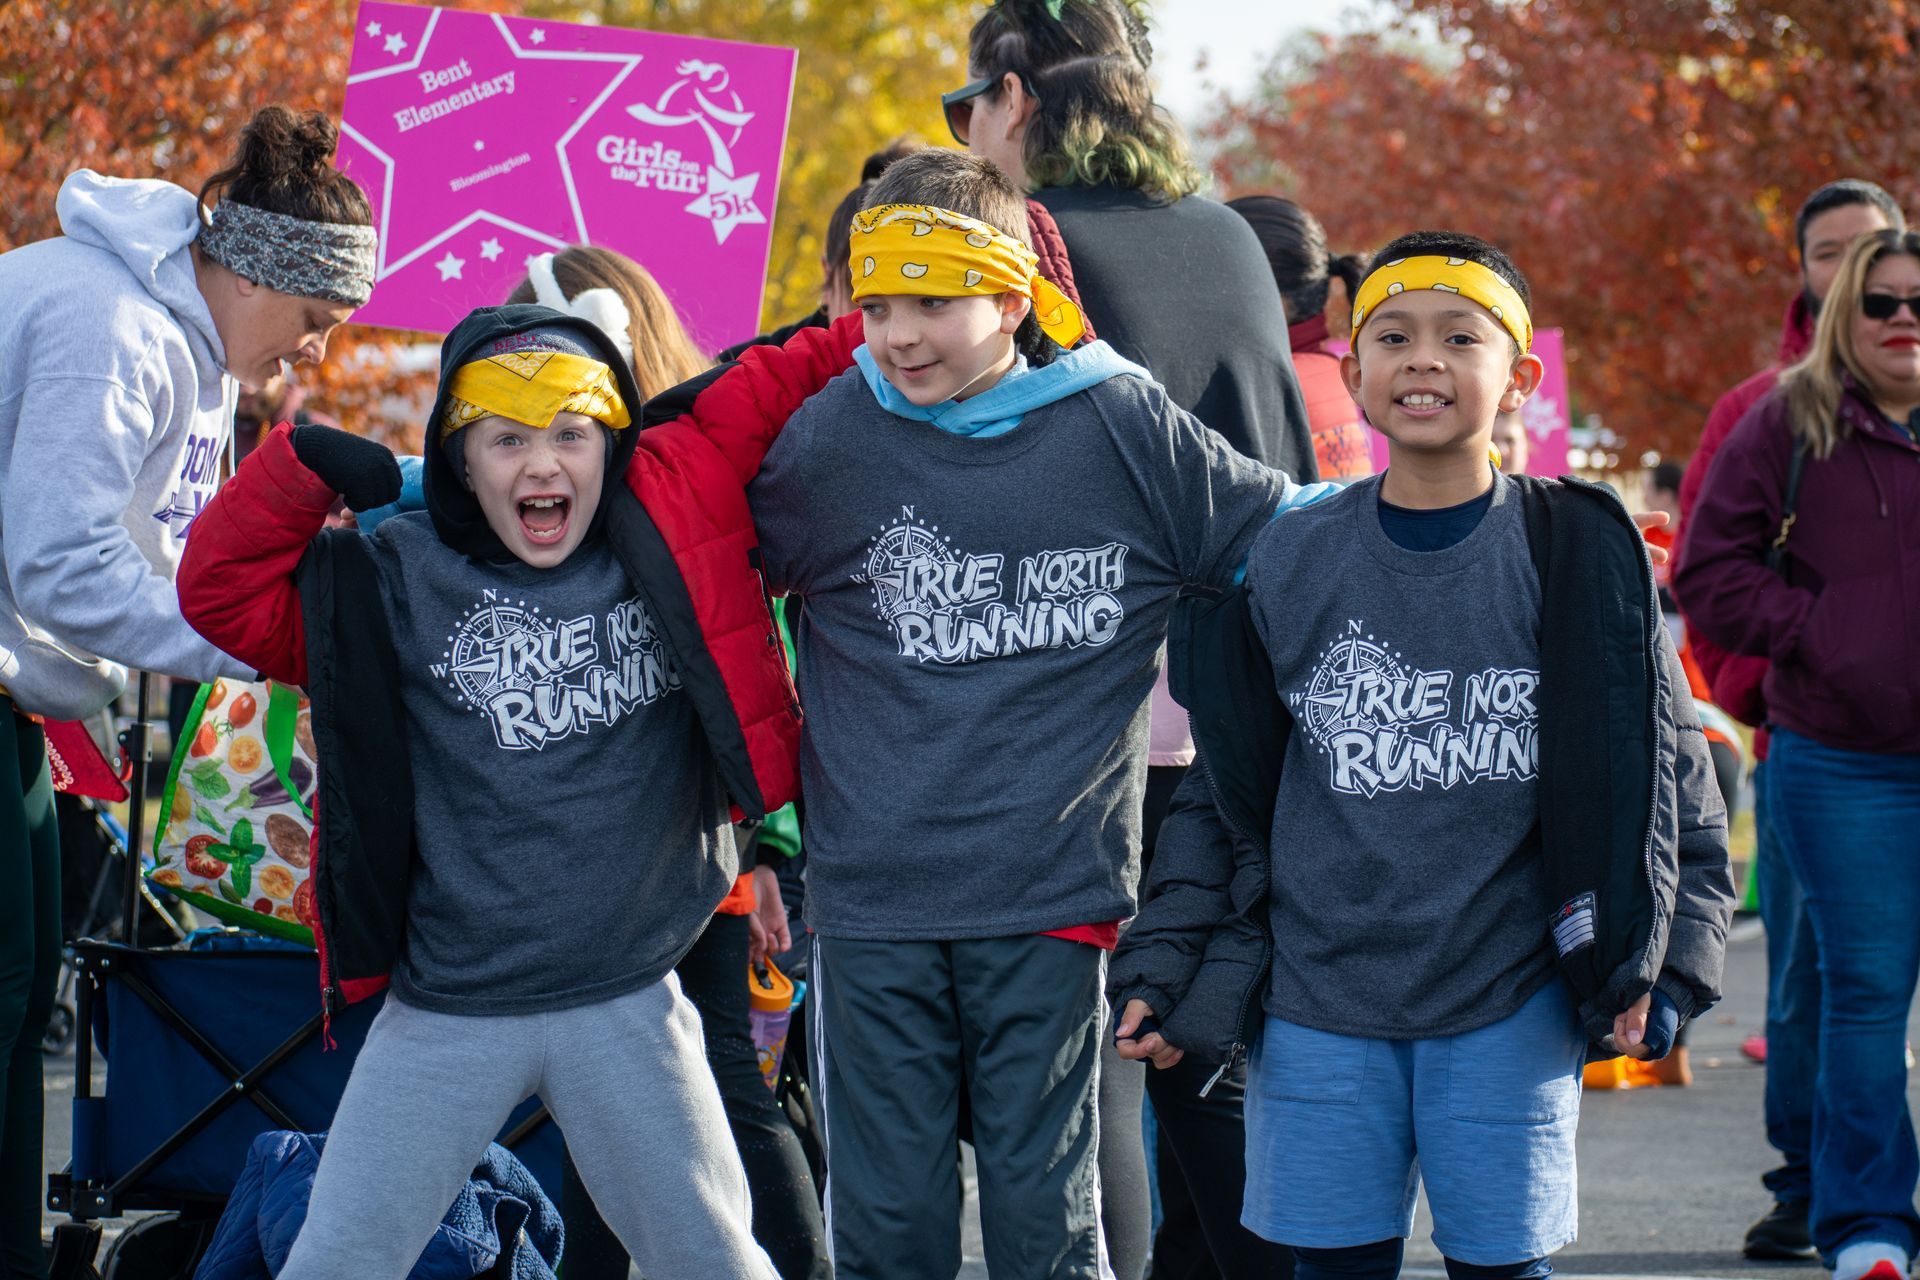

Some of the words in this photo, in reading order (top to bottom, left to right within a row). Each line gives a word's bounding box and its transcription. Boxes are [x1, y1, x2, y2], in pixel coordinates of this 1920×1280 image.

[418, 57, 472, 94] Bent
[393, 70, 515, 133] Elementary
[597, 135, 682, 171] Girls
[681, 161, 700, 173] on
[450, 153, 531, 192] Bloomington
[611, 165, 638, 182] the
[635, 167, 701, 194] run
[902, 505, 914, 520] N
[932, 538, 947, 555] NE
[850, 574, 866, 584] W
[890, 552, 1004, 607] TRUE
[1016, 542, 1129, 607] NORTH
[482, 588, 498, 604] N
[522, 612, 540, 626] NE
[1347, 619, 1363, 635] N
[481, 614, 598, 678] TRUE
[428, 663, 448, 679] W
[1383, 654, 1398, 671] NE
[1289, 692, 1305, 707] W
[1334, 668, 1453, 727] TRUE
[1462, 667, 1540, 727] NOR
